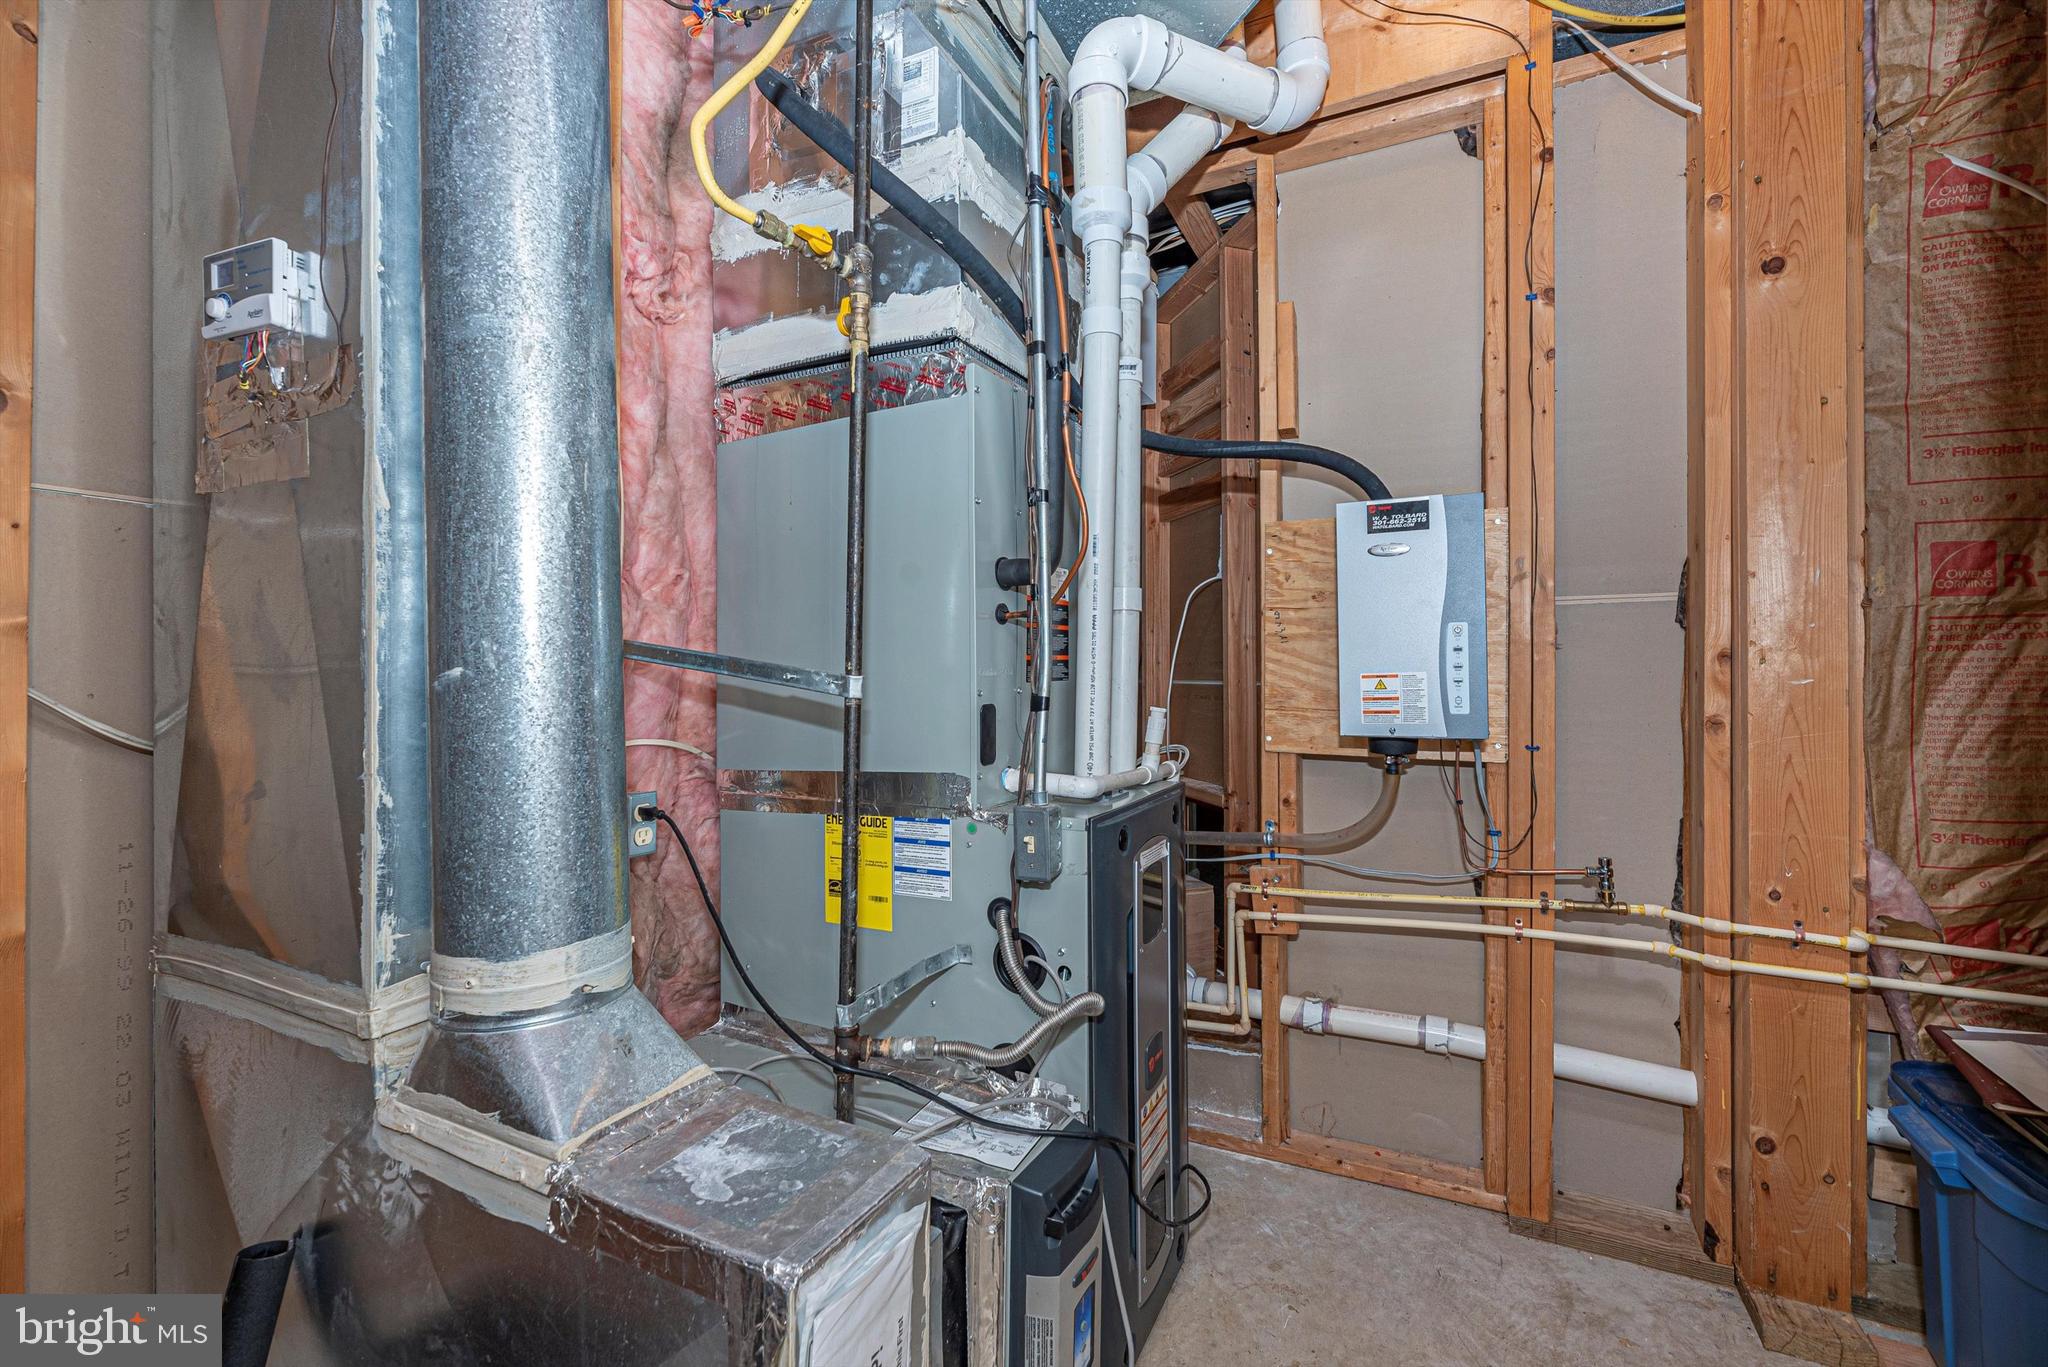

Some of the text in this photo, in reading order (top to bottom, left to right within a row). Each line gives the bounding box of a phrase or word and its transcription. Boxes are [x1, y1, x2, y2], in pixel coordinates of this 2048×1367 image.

[1940, 182, 1988, 197] OWENS
[1928, 193, 1987, 209] CORNING
[1946, 568, 1993, 579] OWENS
[1935, 578, 1993, 589] CORNING
